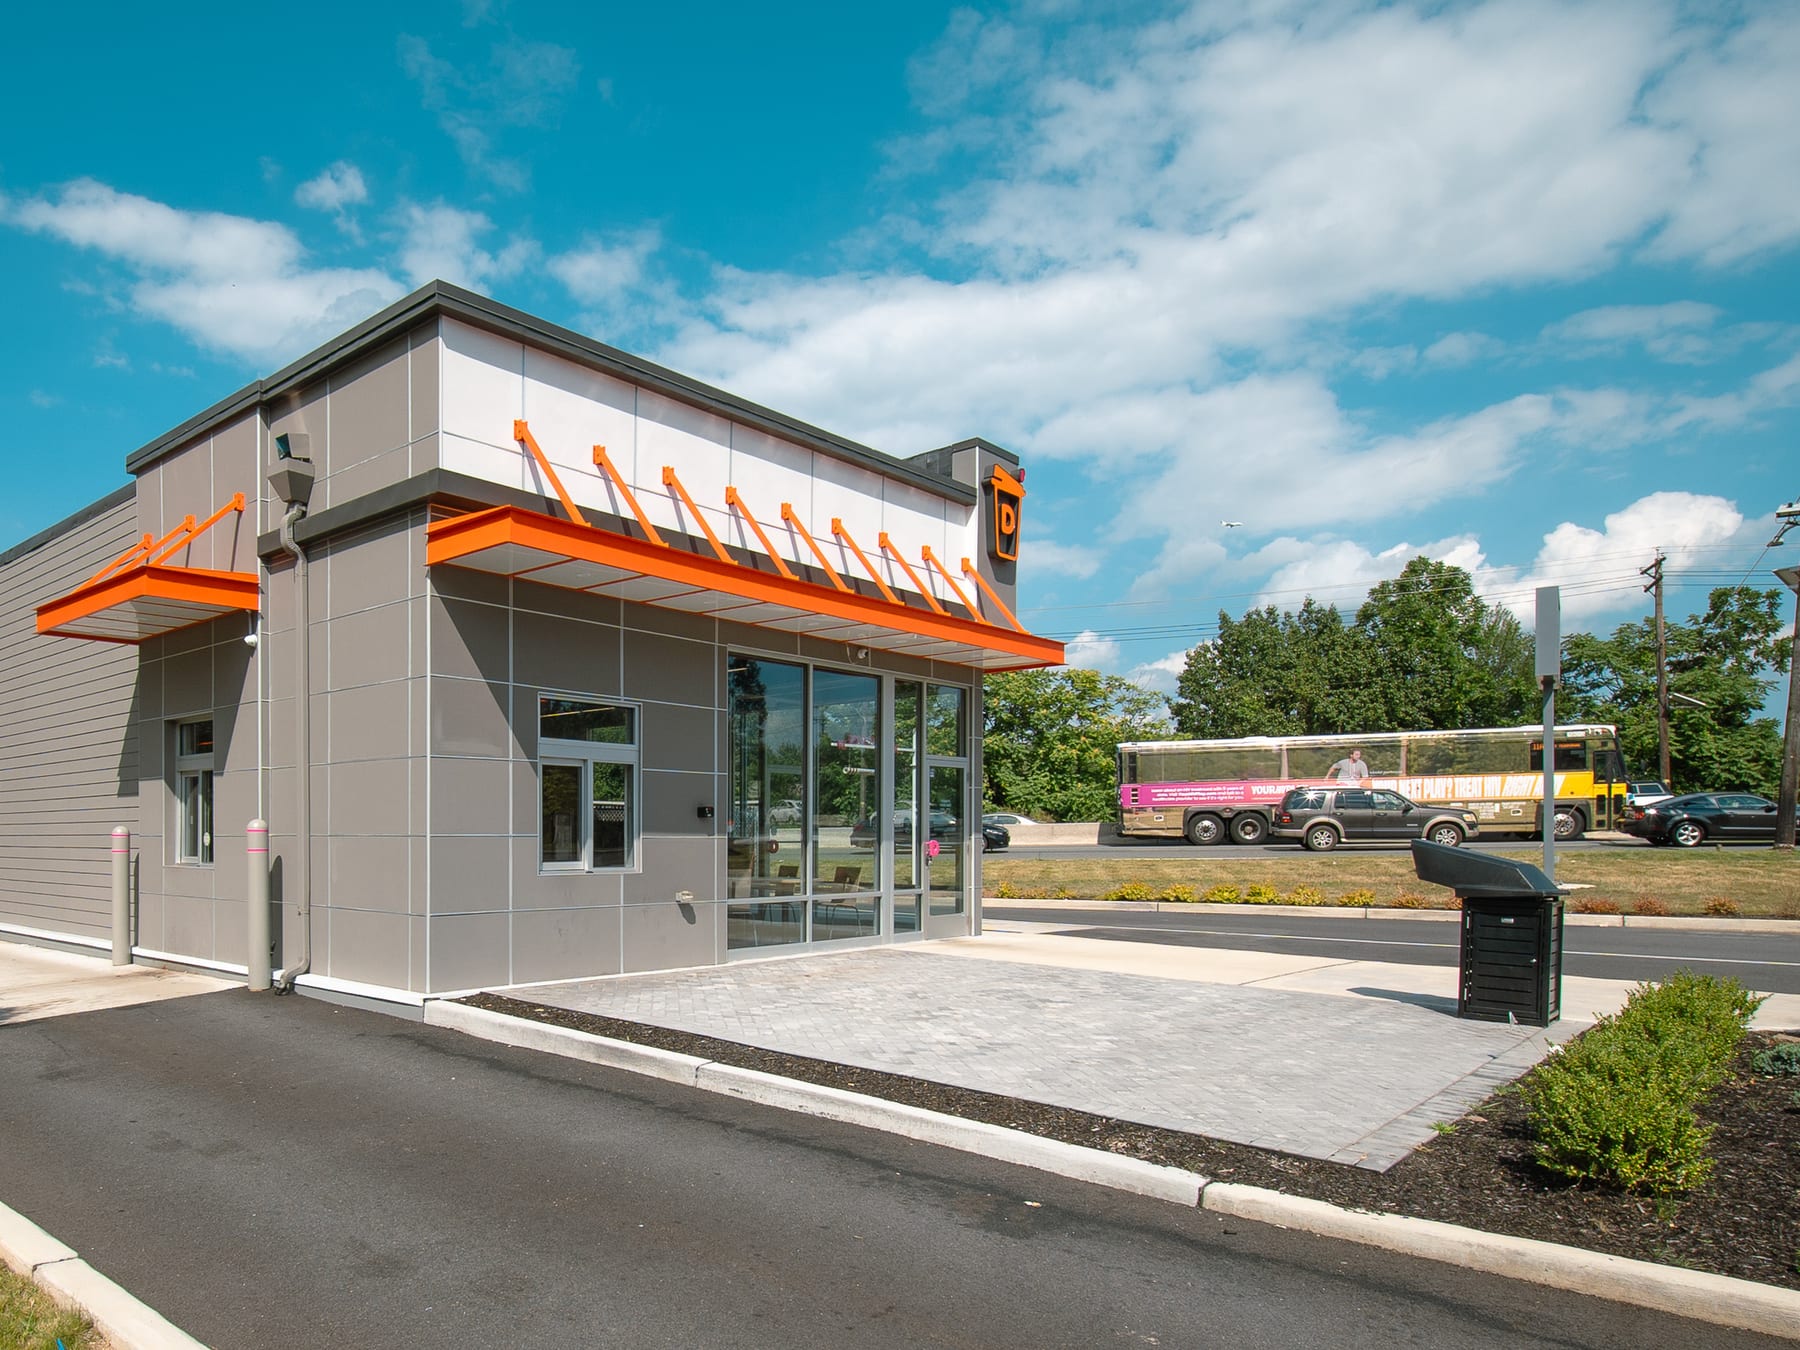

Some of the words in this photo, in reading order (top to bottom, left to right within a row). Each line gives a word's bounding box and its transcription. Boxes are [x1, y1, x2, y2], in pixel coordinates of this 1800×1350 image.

[1001, 503, 1015, 535] D
[1423, 777, 1453, 799] PLAY?
[1454, 776, 1483, 798] TREAT
[1484, 776, 1501, 797] HIV
[1502, 775, 1536, 797] RIGHT
